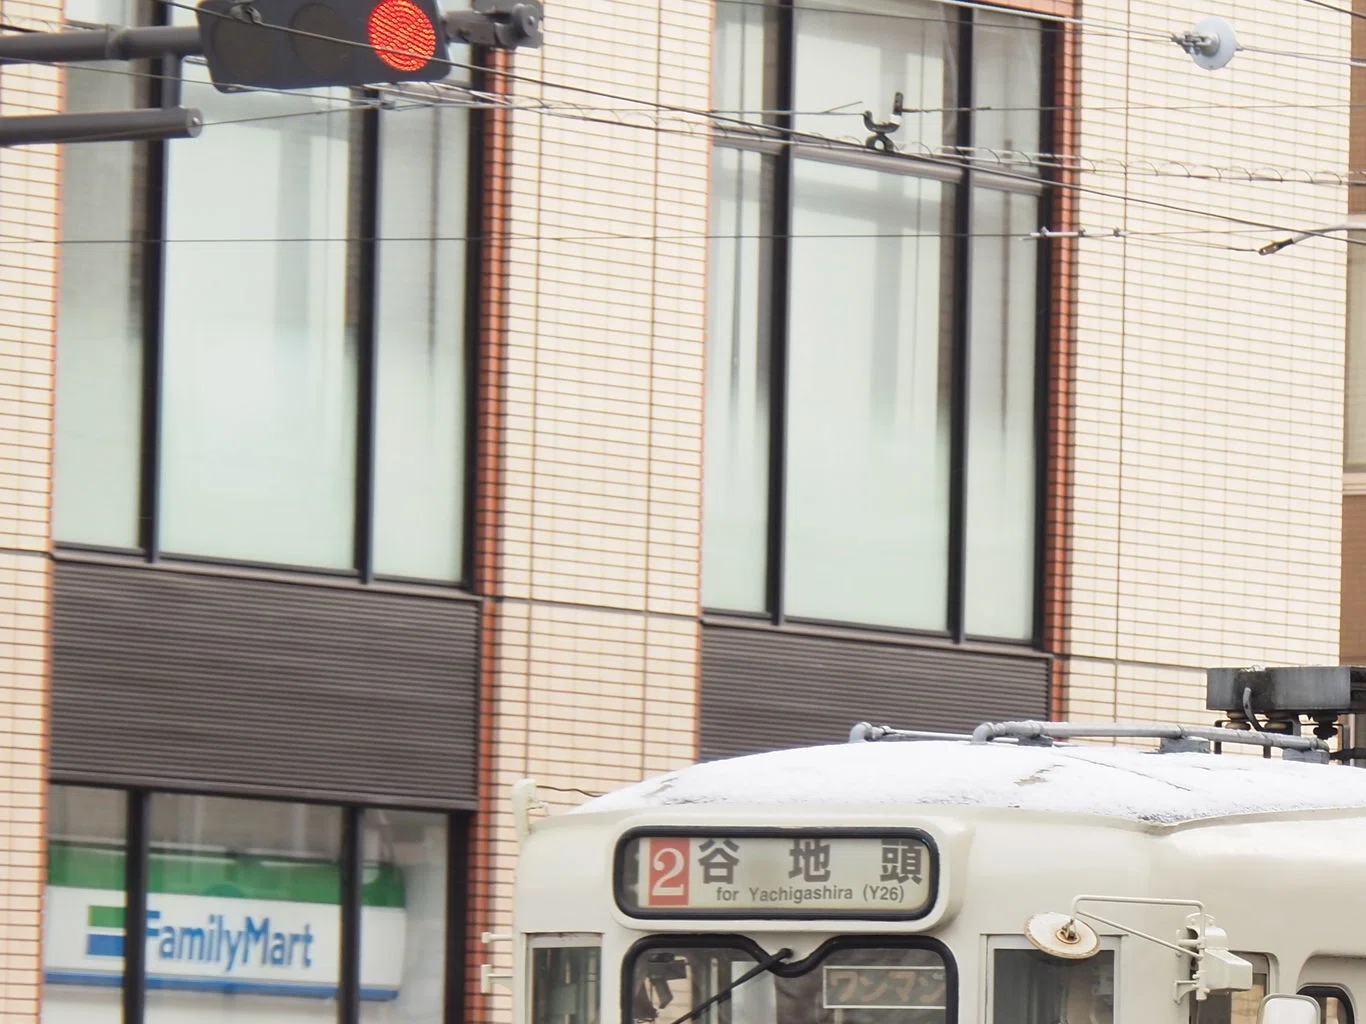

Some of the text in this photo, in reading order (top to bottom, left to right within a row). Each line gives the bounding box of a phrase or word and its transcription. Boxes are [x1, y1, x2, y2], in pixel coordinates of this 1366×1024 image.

[651, 847, 685, 896] 2
[698, 838, 923, 885] 谷地頭
[716, 884, 905, 904] for Yachigashira (Y26)
[146, 910, 314, 971] FamilyMart
